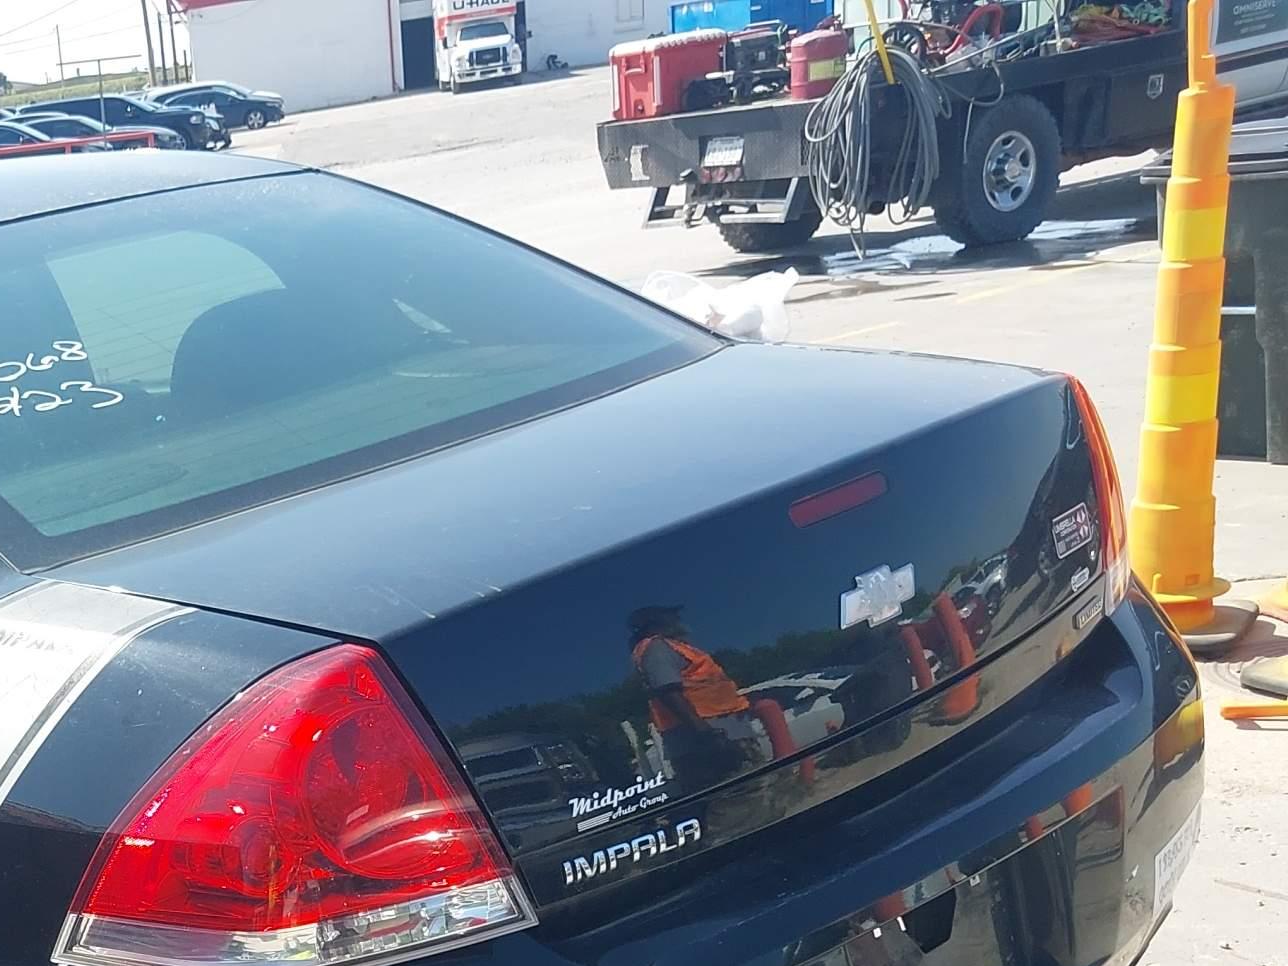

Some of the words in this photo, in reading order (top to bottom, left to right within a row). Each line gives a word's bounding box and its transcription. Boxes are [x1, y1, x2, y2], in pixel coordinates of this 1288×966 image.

[568, 771, 666, 816] Midpoint
[611, 805, 639, 820] Auto
[639, 793, 669, 810] Group
[563, 818, 701, 885] IMPALA
